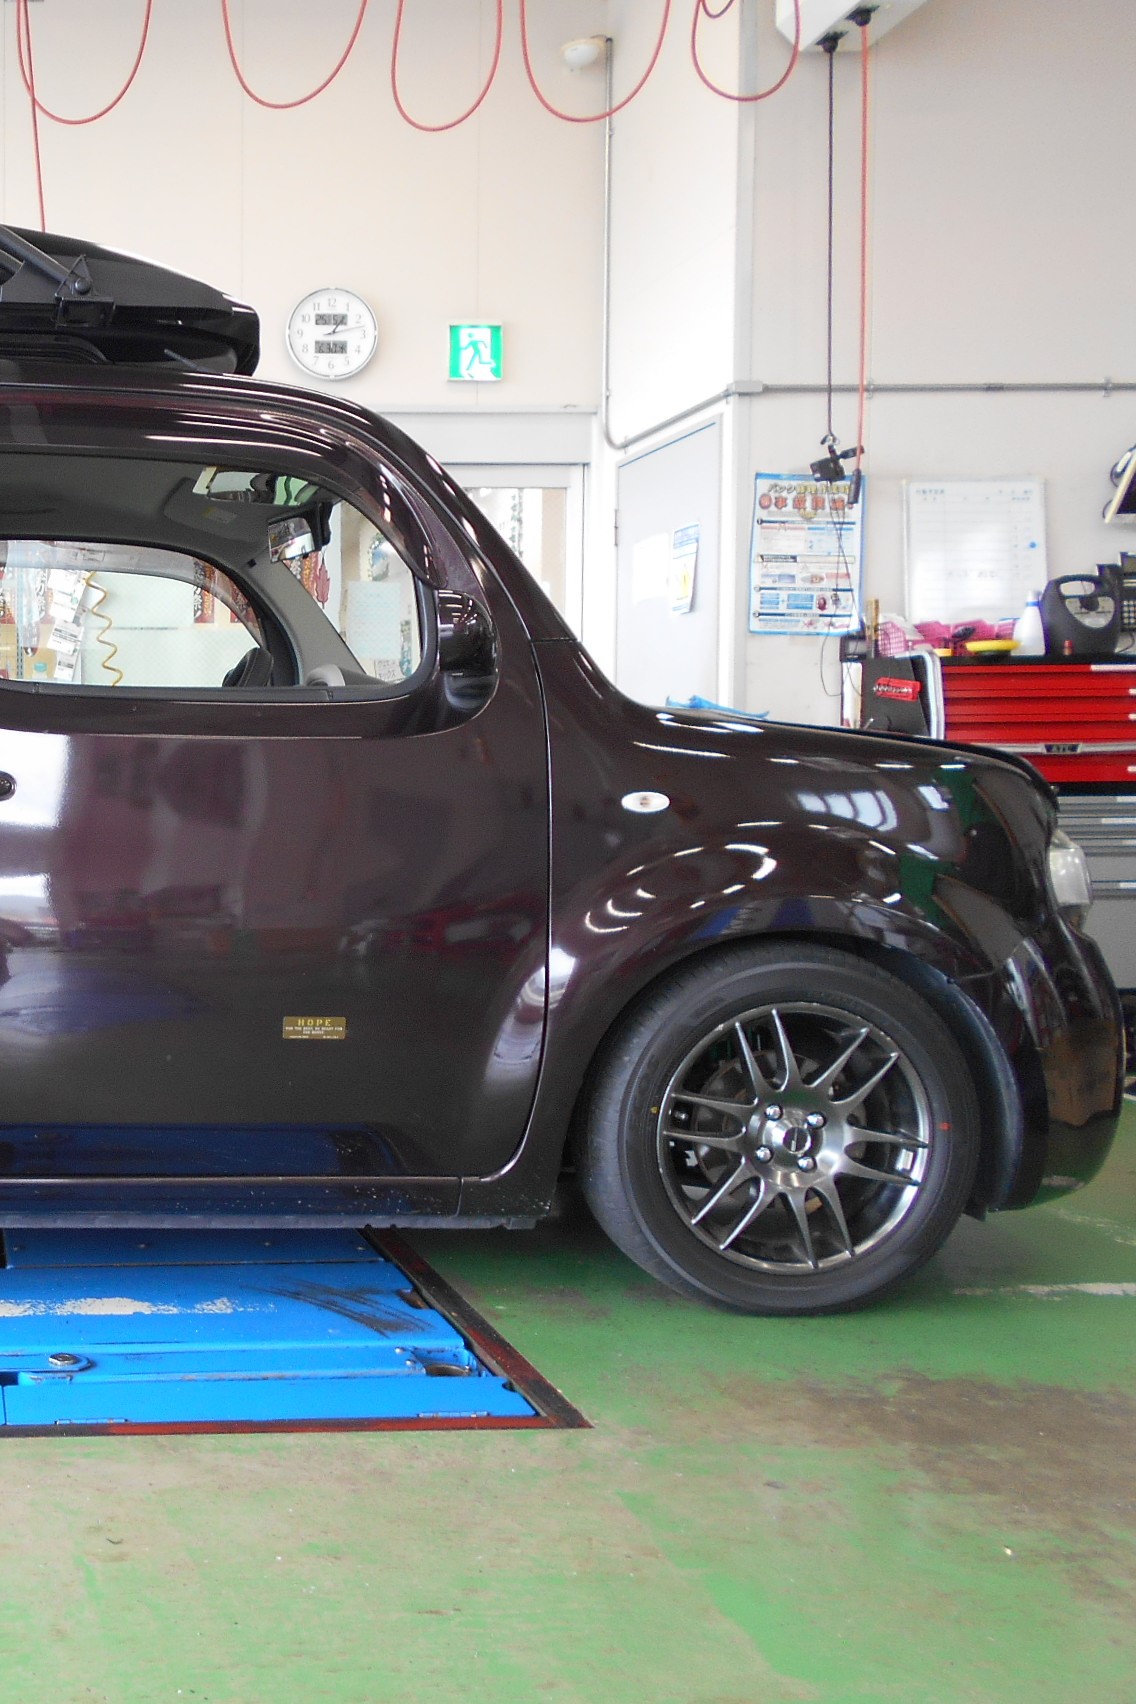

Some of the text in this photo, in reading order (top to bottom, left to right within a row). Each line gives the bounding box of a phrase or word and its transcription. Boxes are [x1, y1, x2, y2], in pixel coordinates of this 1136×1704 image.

[313, 302, 321, 312] 11
[327, 298, 337, 307] 12
[301, 313, 311, 323] 10
[355, 314, 362, 324] 2
[297, 329, 304, 338] 9
[301, 344, 309, 353] 8
[354, 345, 361, 354] 4
[313, 355, 320, 366] 7
[327, 360, 335, 369] 6
